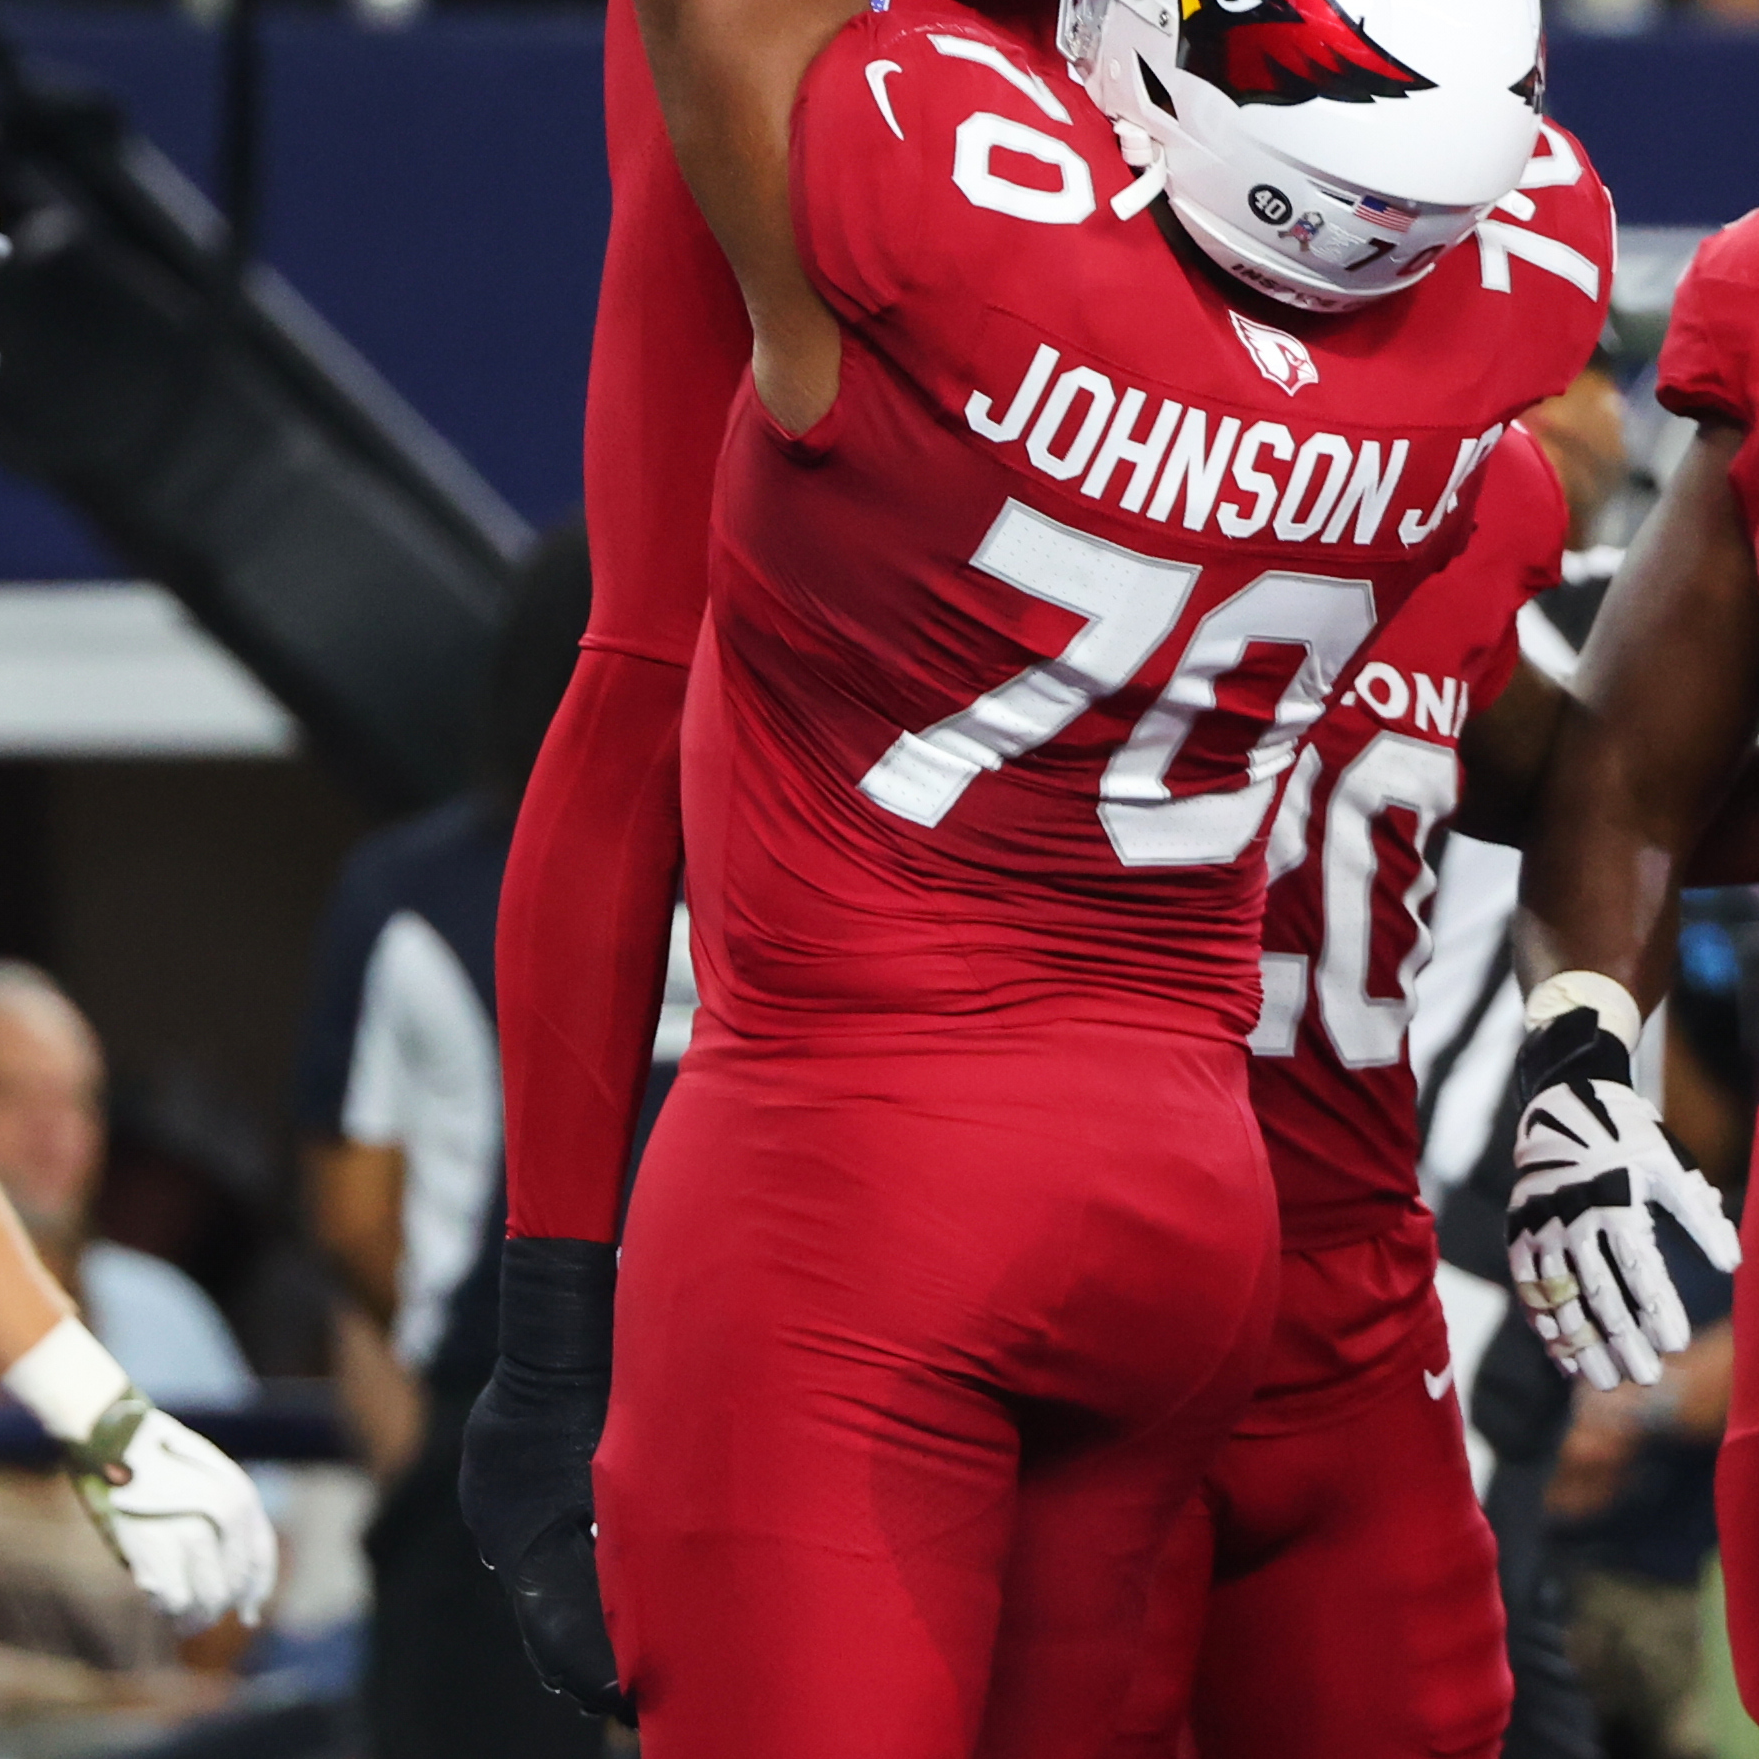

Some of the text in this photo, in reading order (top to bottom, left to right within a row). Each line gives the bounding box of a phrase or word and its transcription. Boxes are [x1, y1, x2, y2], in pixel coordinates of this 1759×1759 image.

[1254, 189, 1288, 221] 40
[964, 343, 1410, 545] JOHNSON
[856, 496, 1378, 866] 70
